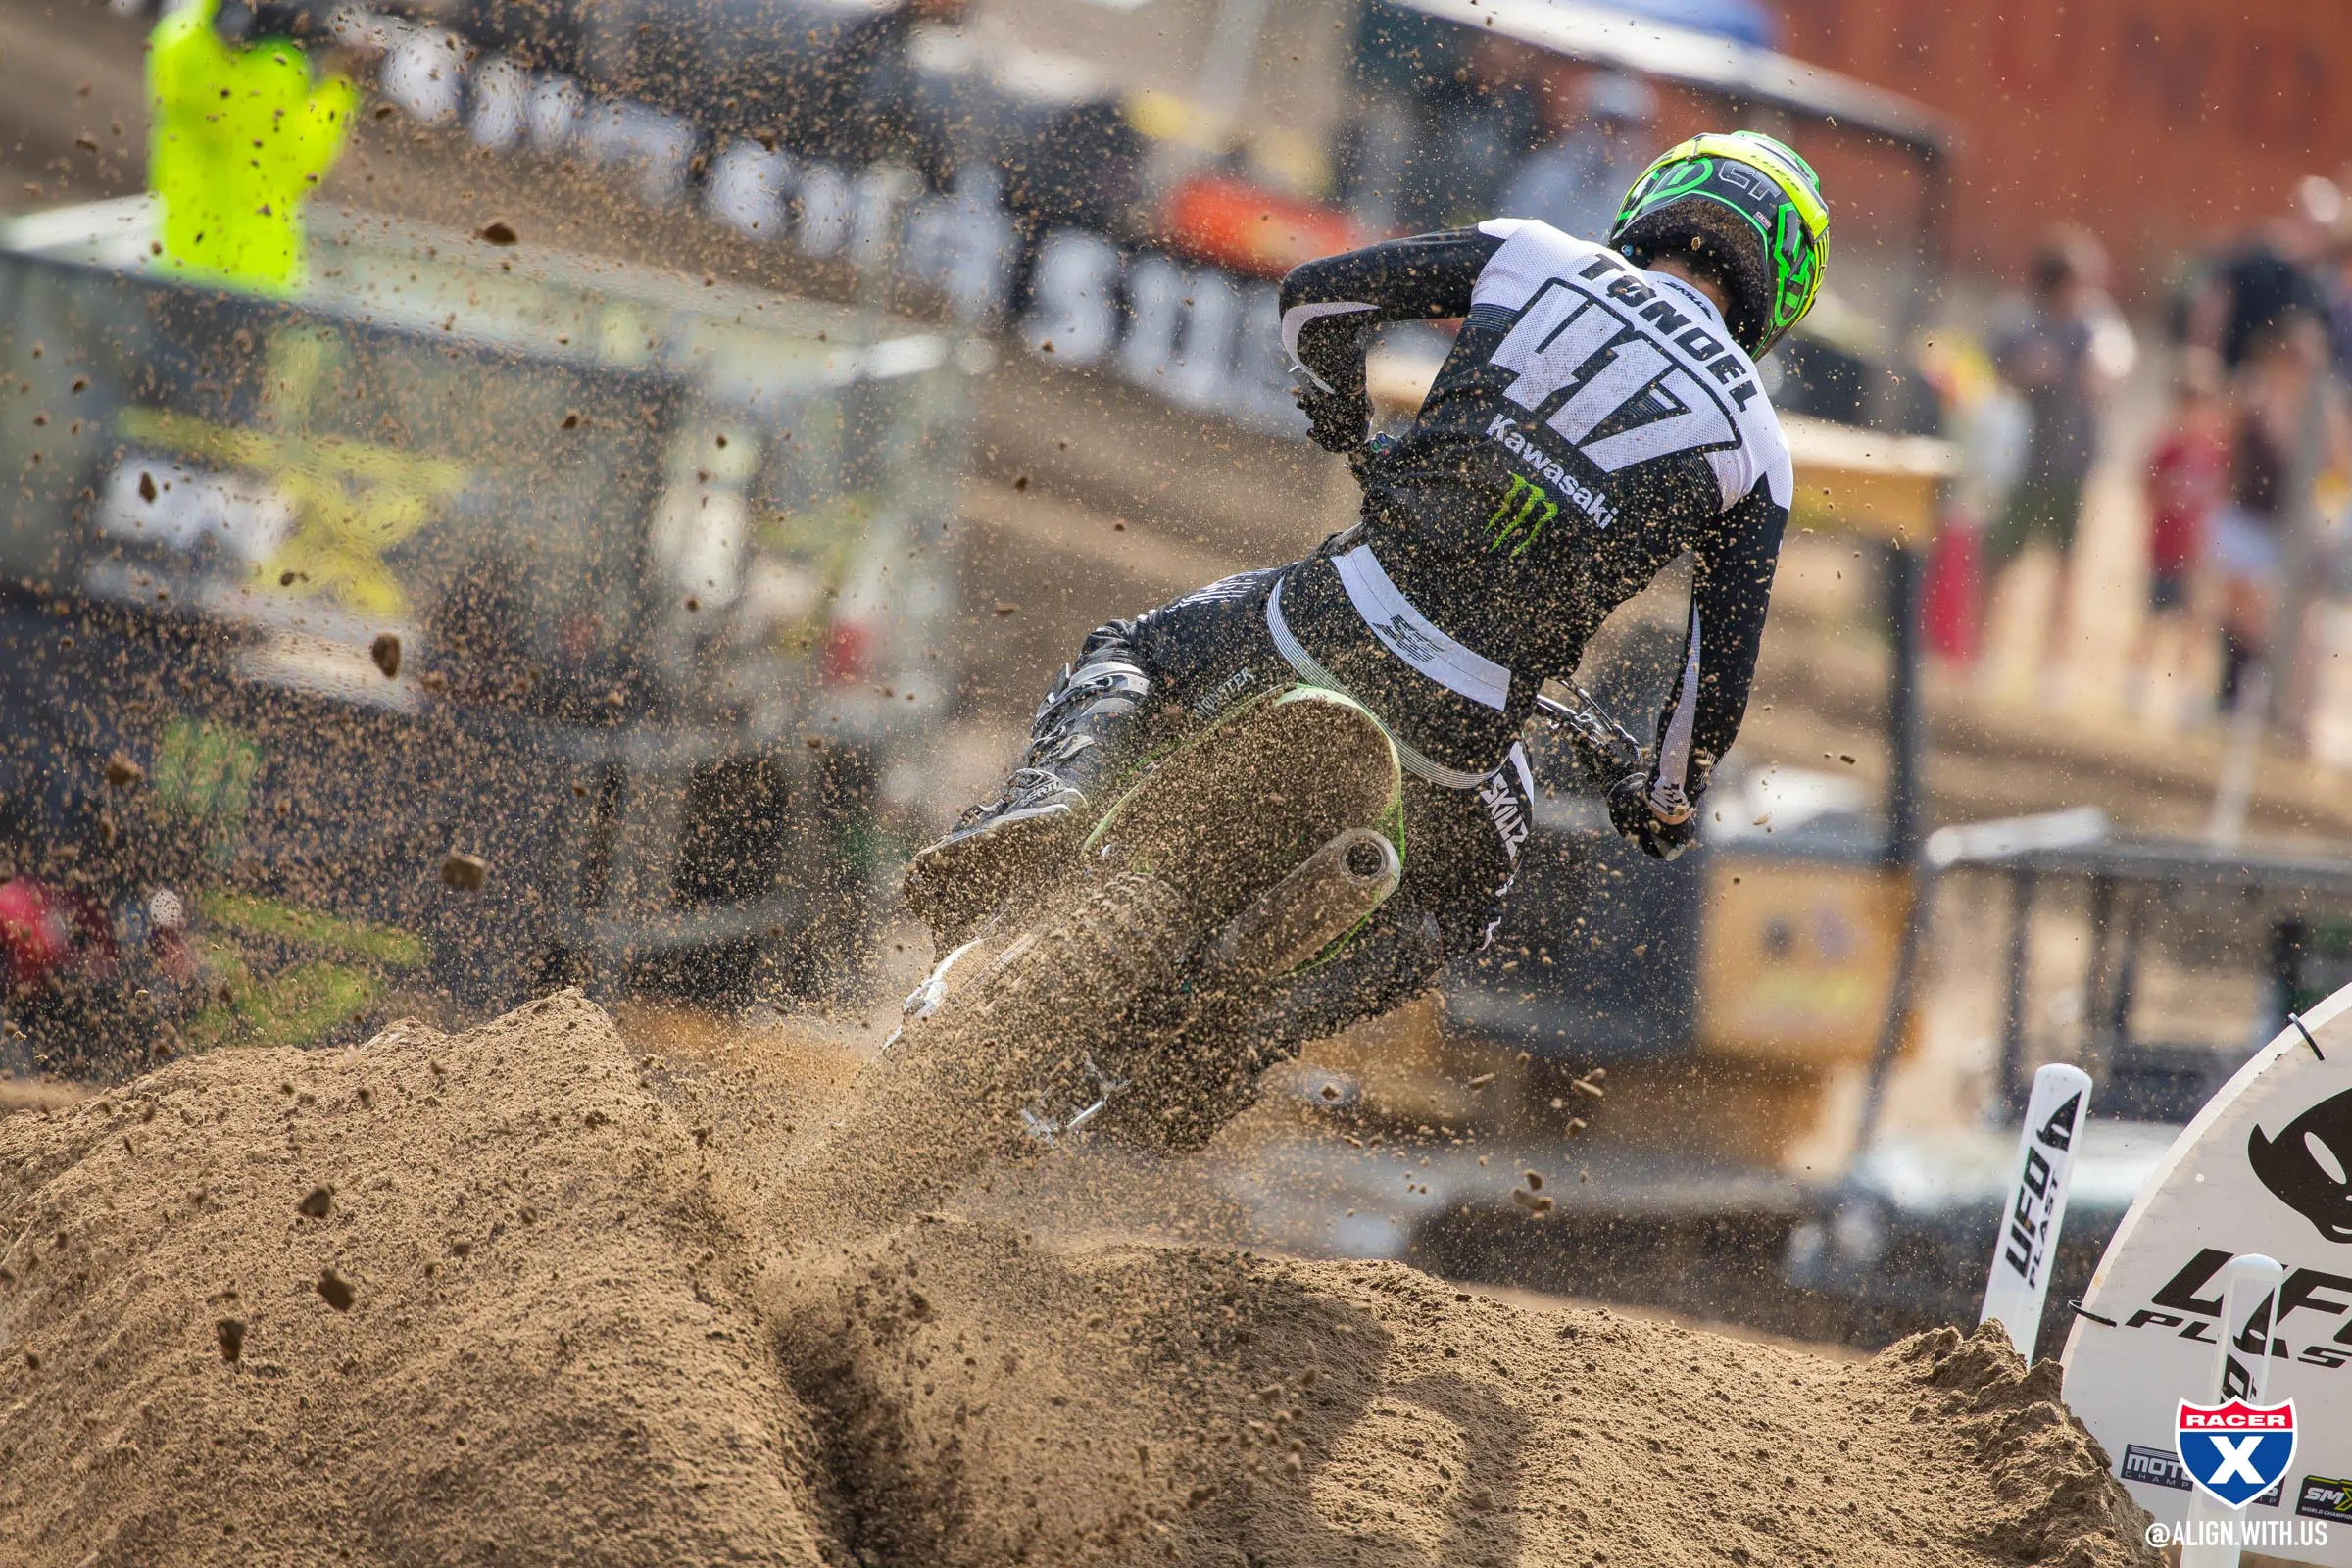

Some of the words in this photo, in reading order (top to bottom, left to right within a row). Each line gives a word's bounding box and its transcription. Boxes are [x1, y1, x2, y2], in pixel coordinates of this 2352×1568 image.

[1489, 278, 1741, 474] 417
[1485, 413, 1619, 530] Kawasaki
[1480, 773, 1529, 862] SKILLZ
[2005, 1146, 2050, 1278] UFO
[2029, 1170, 2058, 1290] PLAST
[2151, 1247, 2352, 1346] UF
[2301, 1505, 2324, 1515] WORLD
